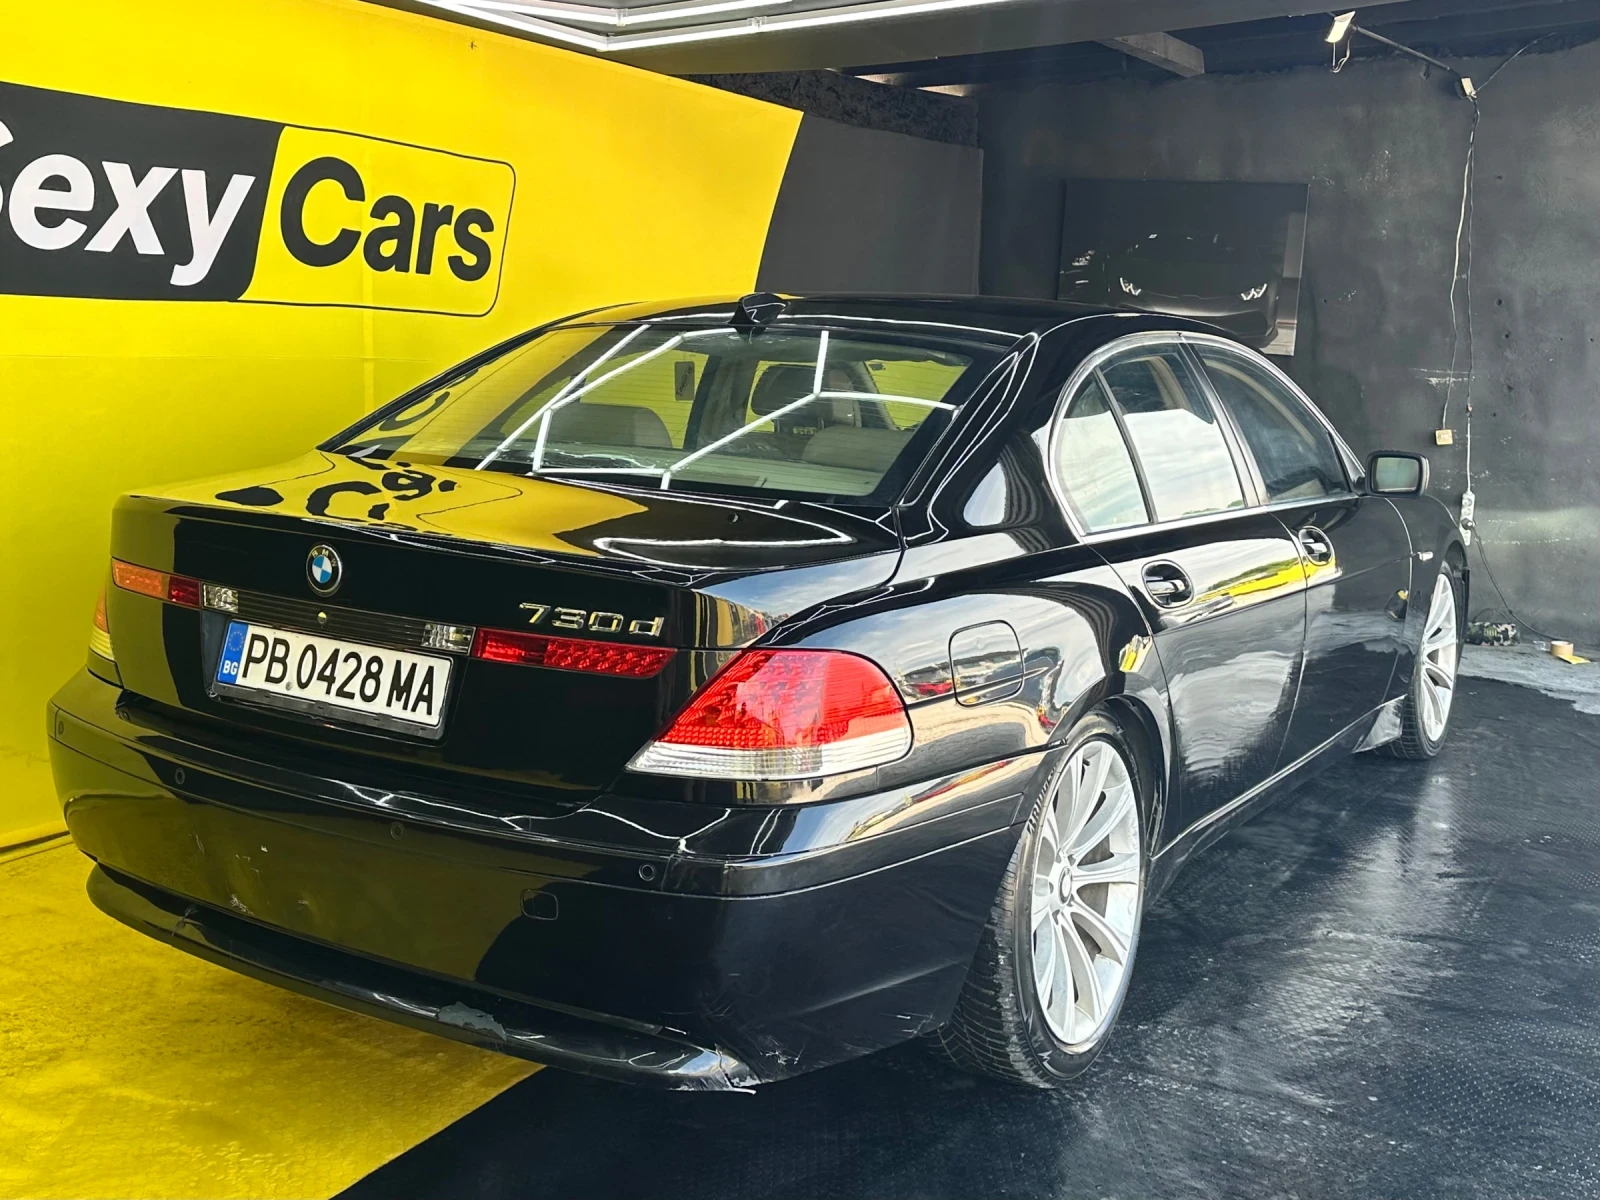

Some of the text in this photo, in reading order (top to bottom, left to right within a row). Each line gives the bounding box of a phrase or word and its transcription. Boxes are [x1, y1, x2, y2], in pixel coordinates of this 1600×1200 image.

[0, 120, 494, 286] exy Cars
[311, 548, 338, 567] BMW
[519, 602, 665, 637] 730d
[222, 659, 239, 676] BG
[242, 633, 435, 716] PB 0428 MA
